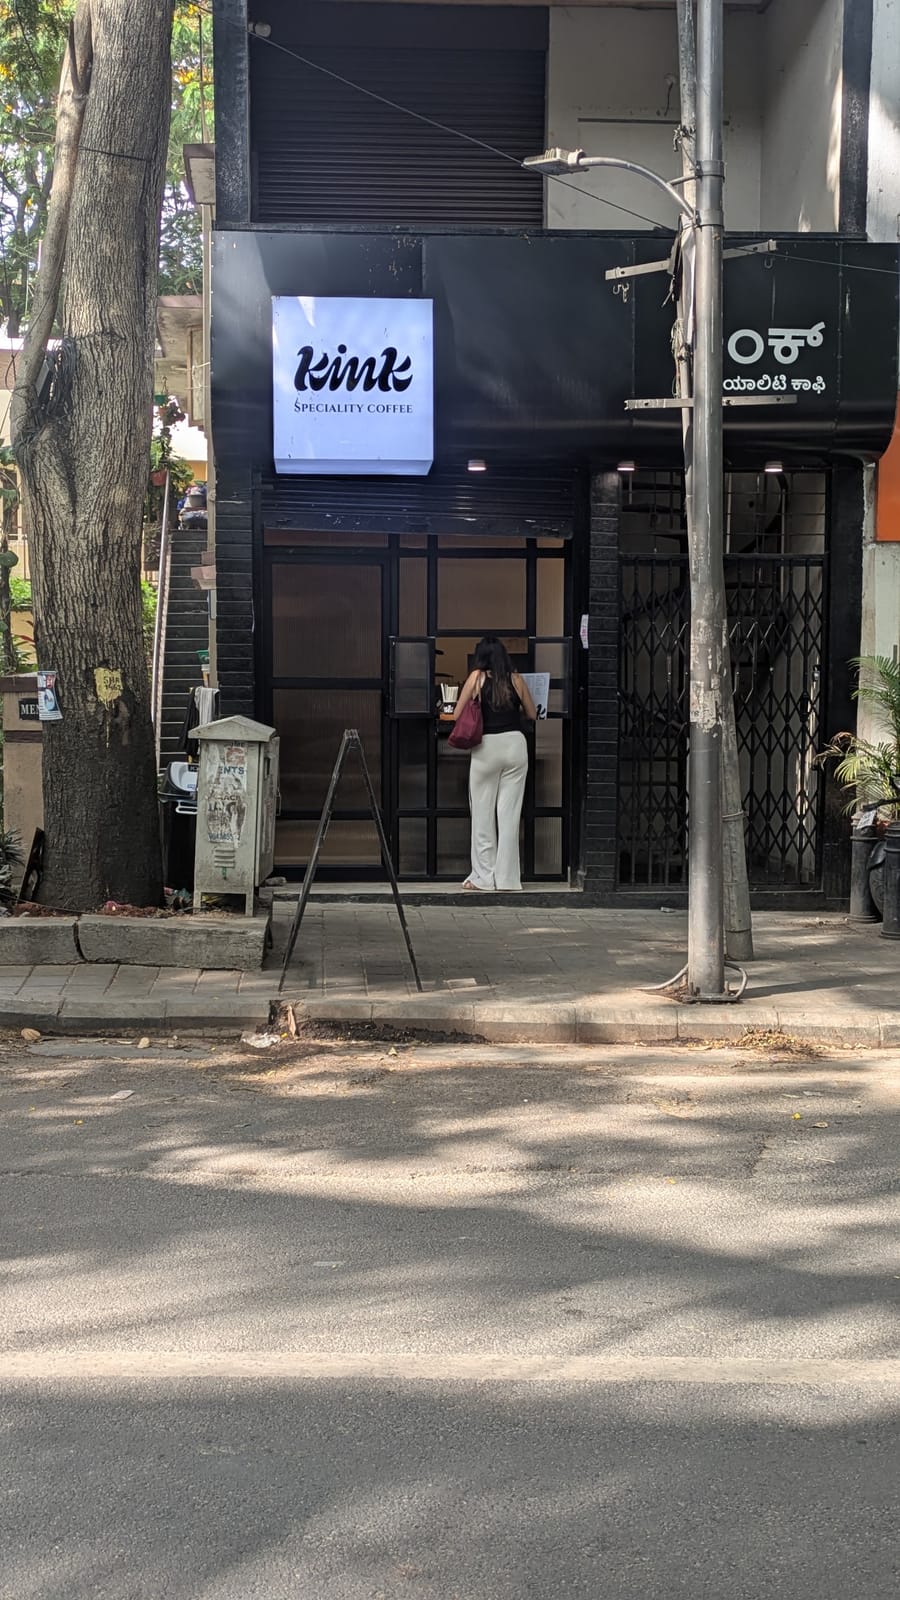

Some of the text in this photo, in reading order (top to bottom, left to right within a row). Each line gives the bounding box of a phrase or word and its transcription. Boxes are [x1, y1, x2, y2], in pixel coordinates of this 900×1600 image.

[727, 321, 826, 365] ಂಕ್
[294, 344, 413, 392] kink
[722, 374, 826, 394] ಯಾಲಿಟಿ ಕಾಫಿ
[294, 402, 413, 414] SPECIALITY COFFEE
